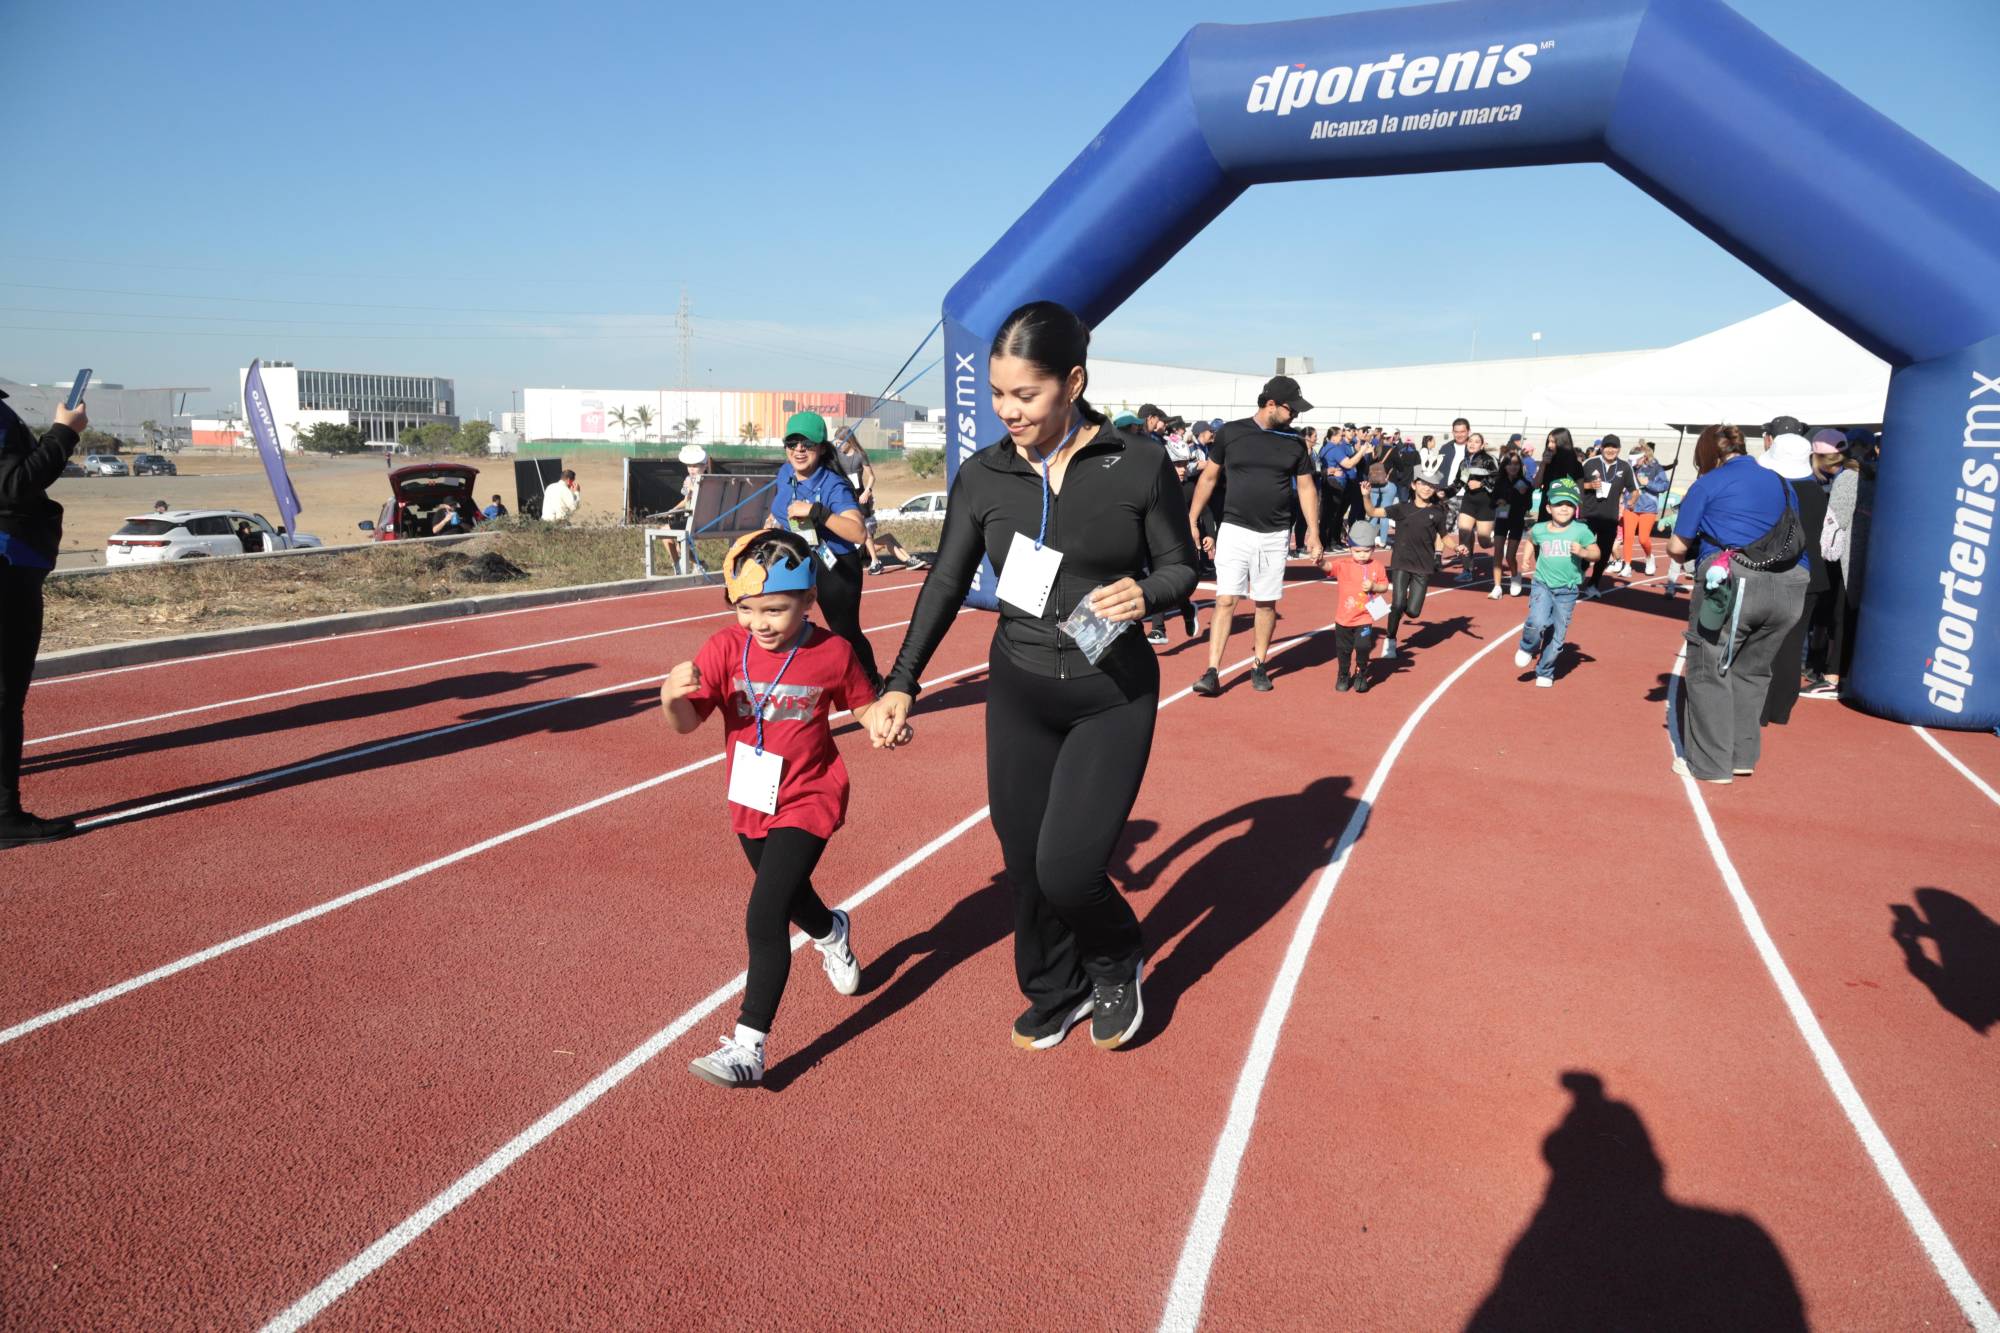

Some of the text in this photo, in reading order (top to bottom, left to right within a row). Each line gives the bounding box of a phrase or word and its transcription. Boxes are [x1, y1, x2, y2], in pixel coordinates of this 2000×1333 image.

[1247, 44, 1539, 116] dportenis
[1310, 104, 1523, 140] Alcanza la mejor marca
